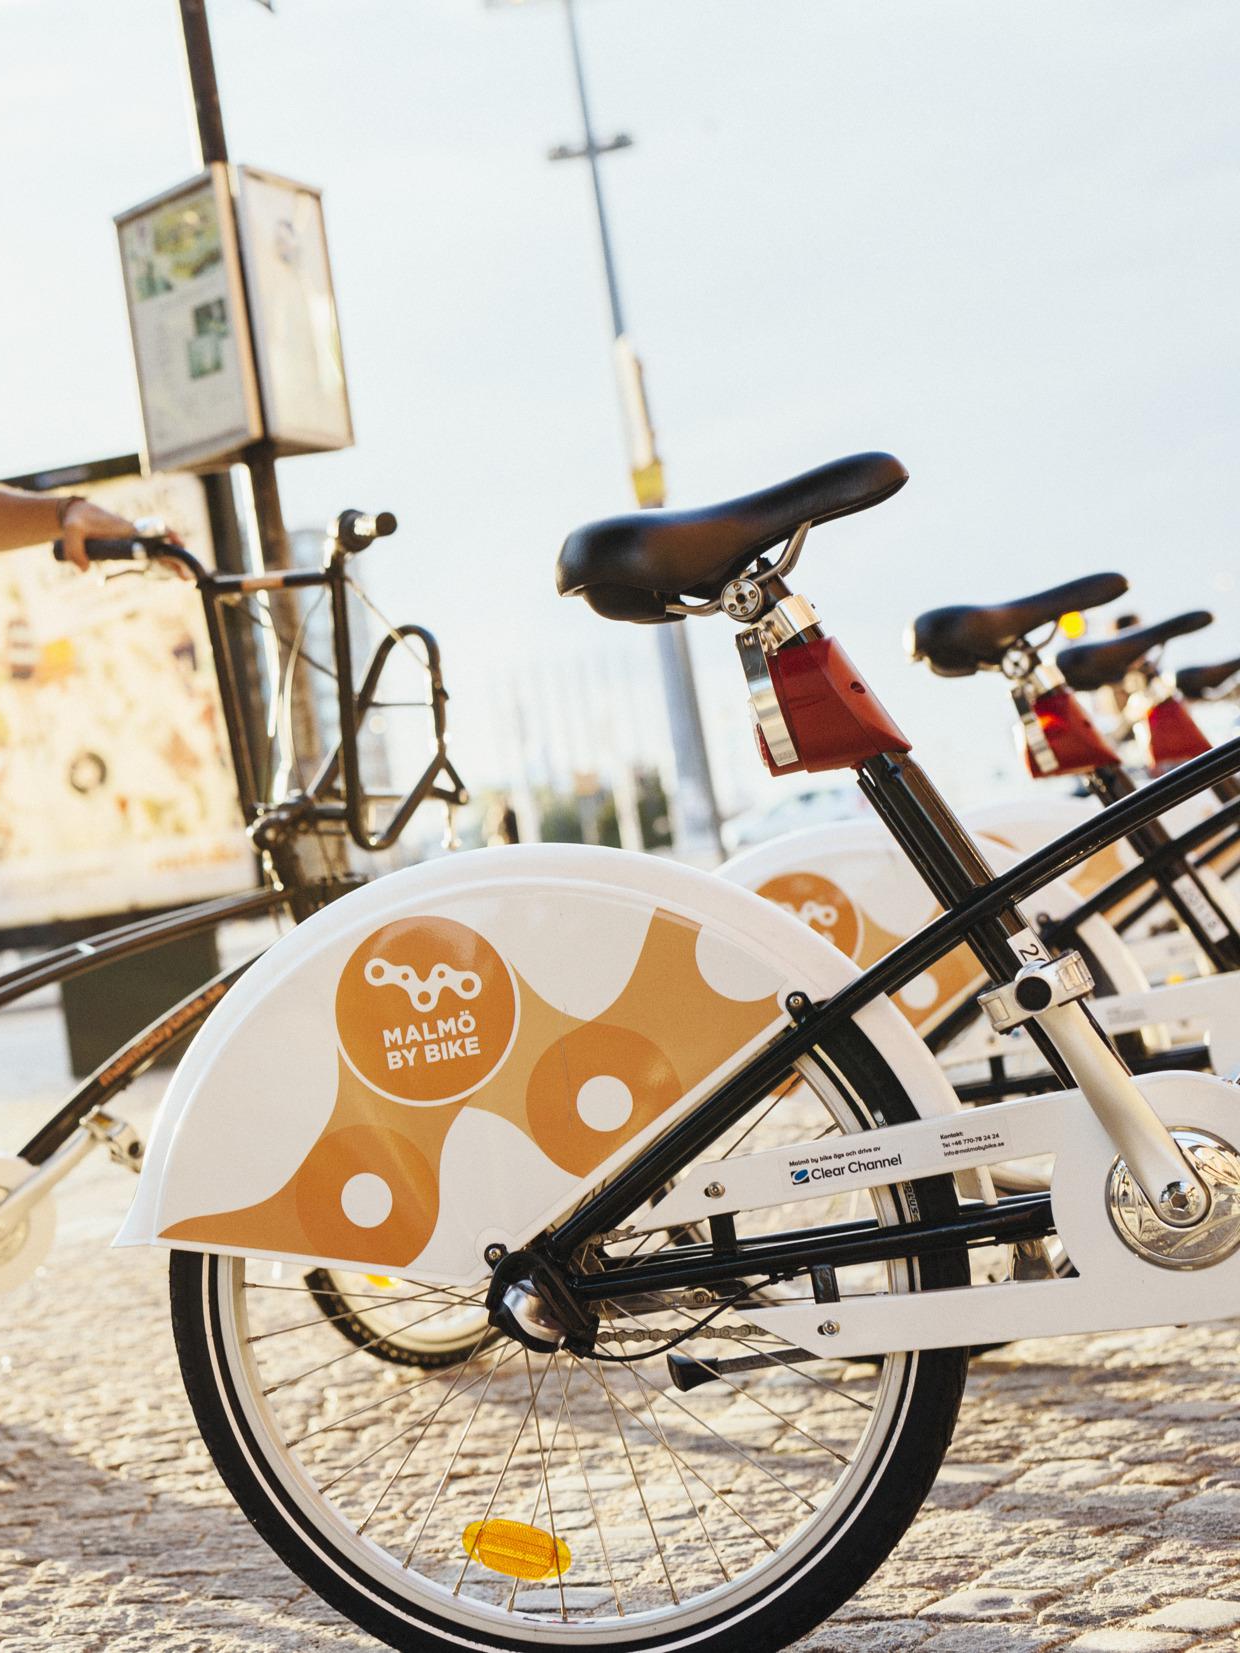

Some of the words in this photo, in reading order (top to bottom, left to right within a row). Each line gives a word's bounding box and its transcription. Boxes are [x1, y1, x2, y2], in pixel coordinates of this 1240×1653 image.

[382, 1010, 476, 1048] MALMÖ
[386, 1047, 418, 1071] BY
[423, 1036, 481, 1064] BIKE
[811, 1165, 846, 1180] Clear
[848, 1153, 903, 1174] Channel
[858, 1147, 872, 1155] drivs
